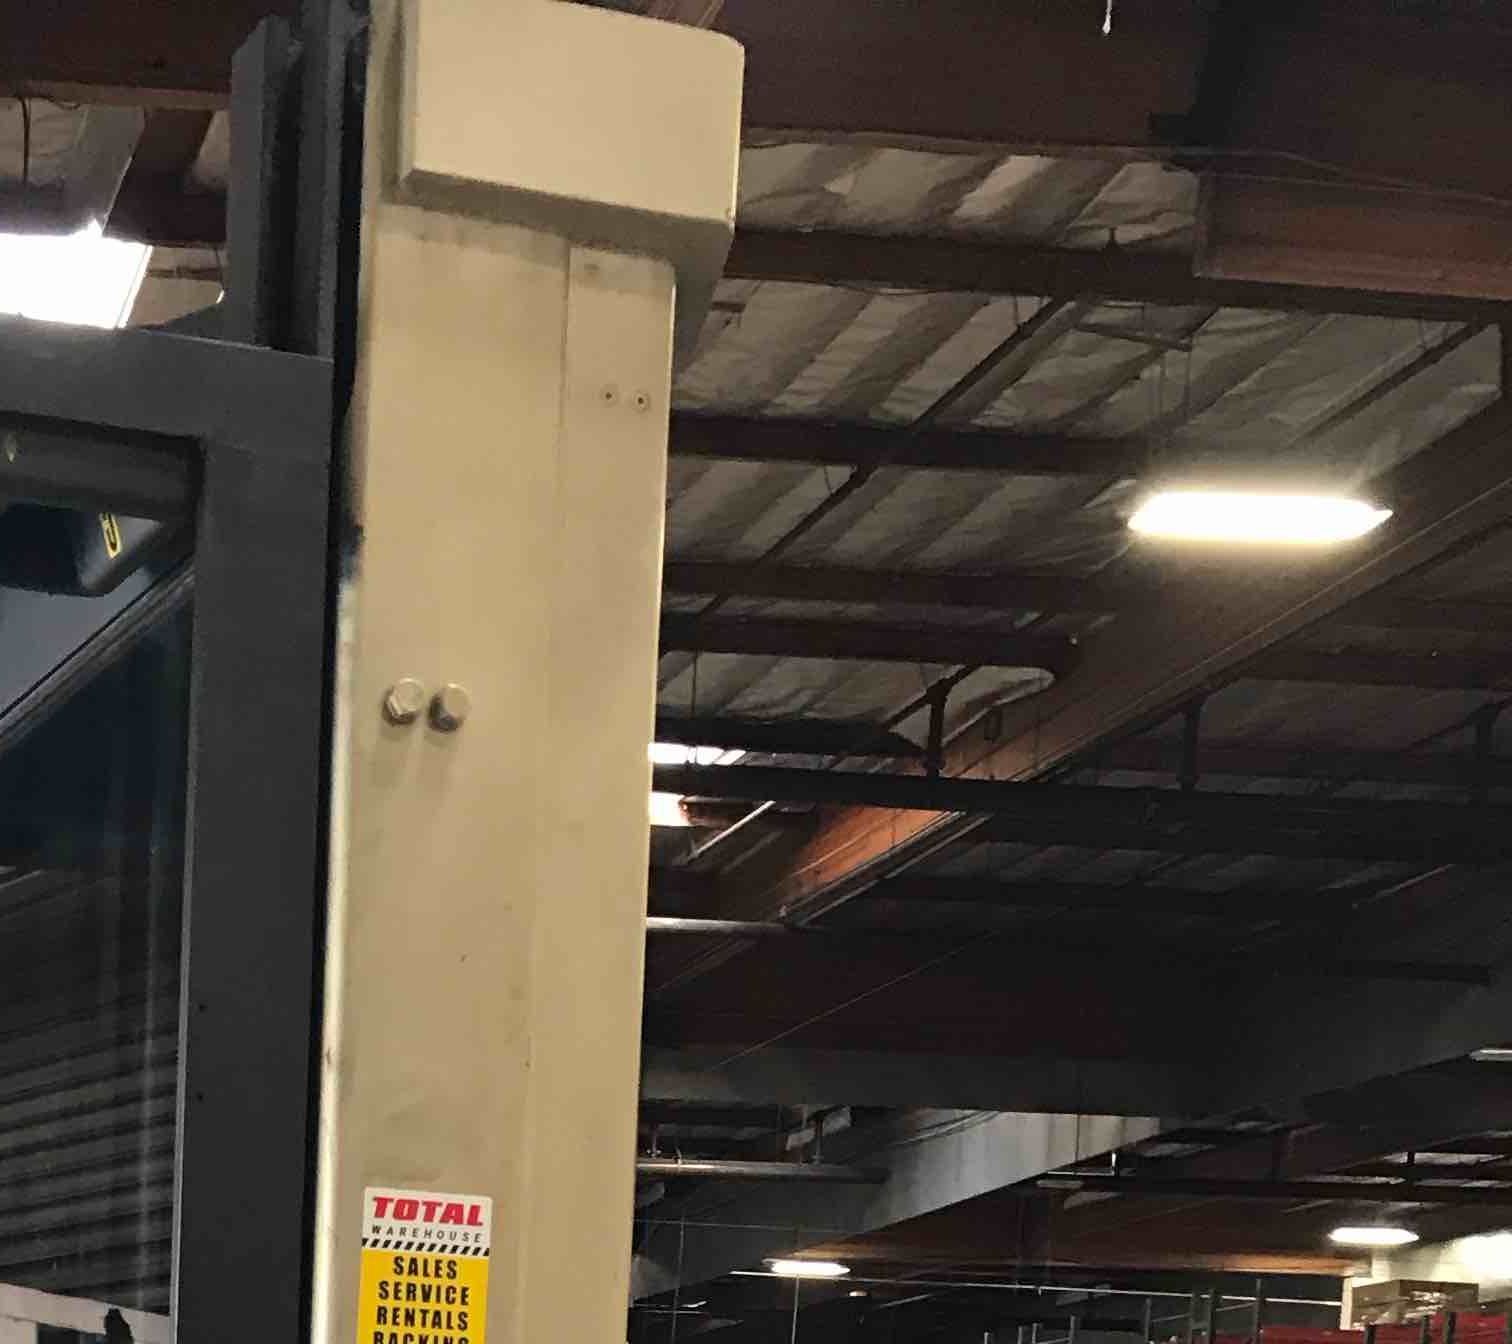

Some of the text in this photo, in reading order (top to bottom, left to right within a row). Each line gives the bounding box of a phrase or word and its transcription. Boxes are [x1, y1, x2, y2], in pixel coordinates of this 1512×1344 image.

[372, 1195, 484, 1227] TOTAL
[371, 1225, 482, 1243] WAREHOUSE
[393, 1255, 458, 1280] SALES
[378, 1280, 469, 1306] SERVICE
[376, 1305, 469, 1332] RENTALS
